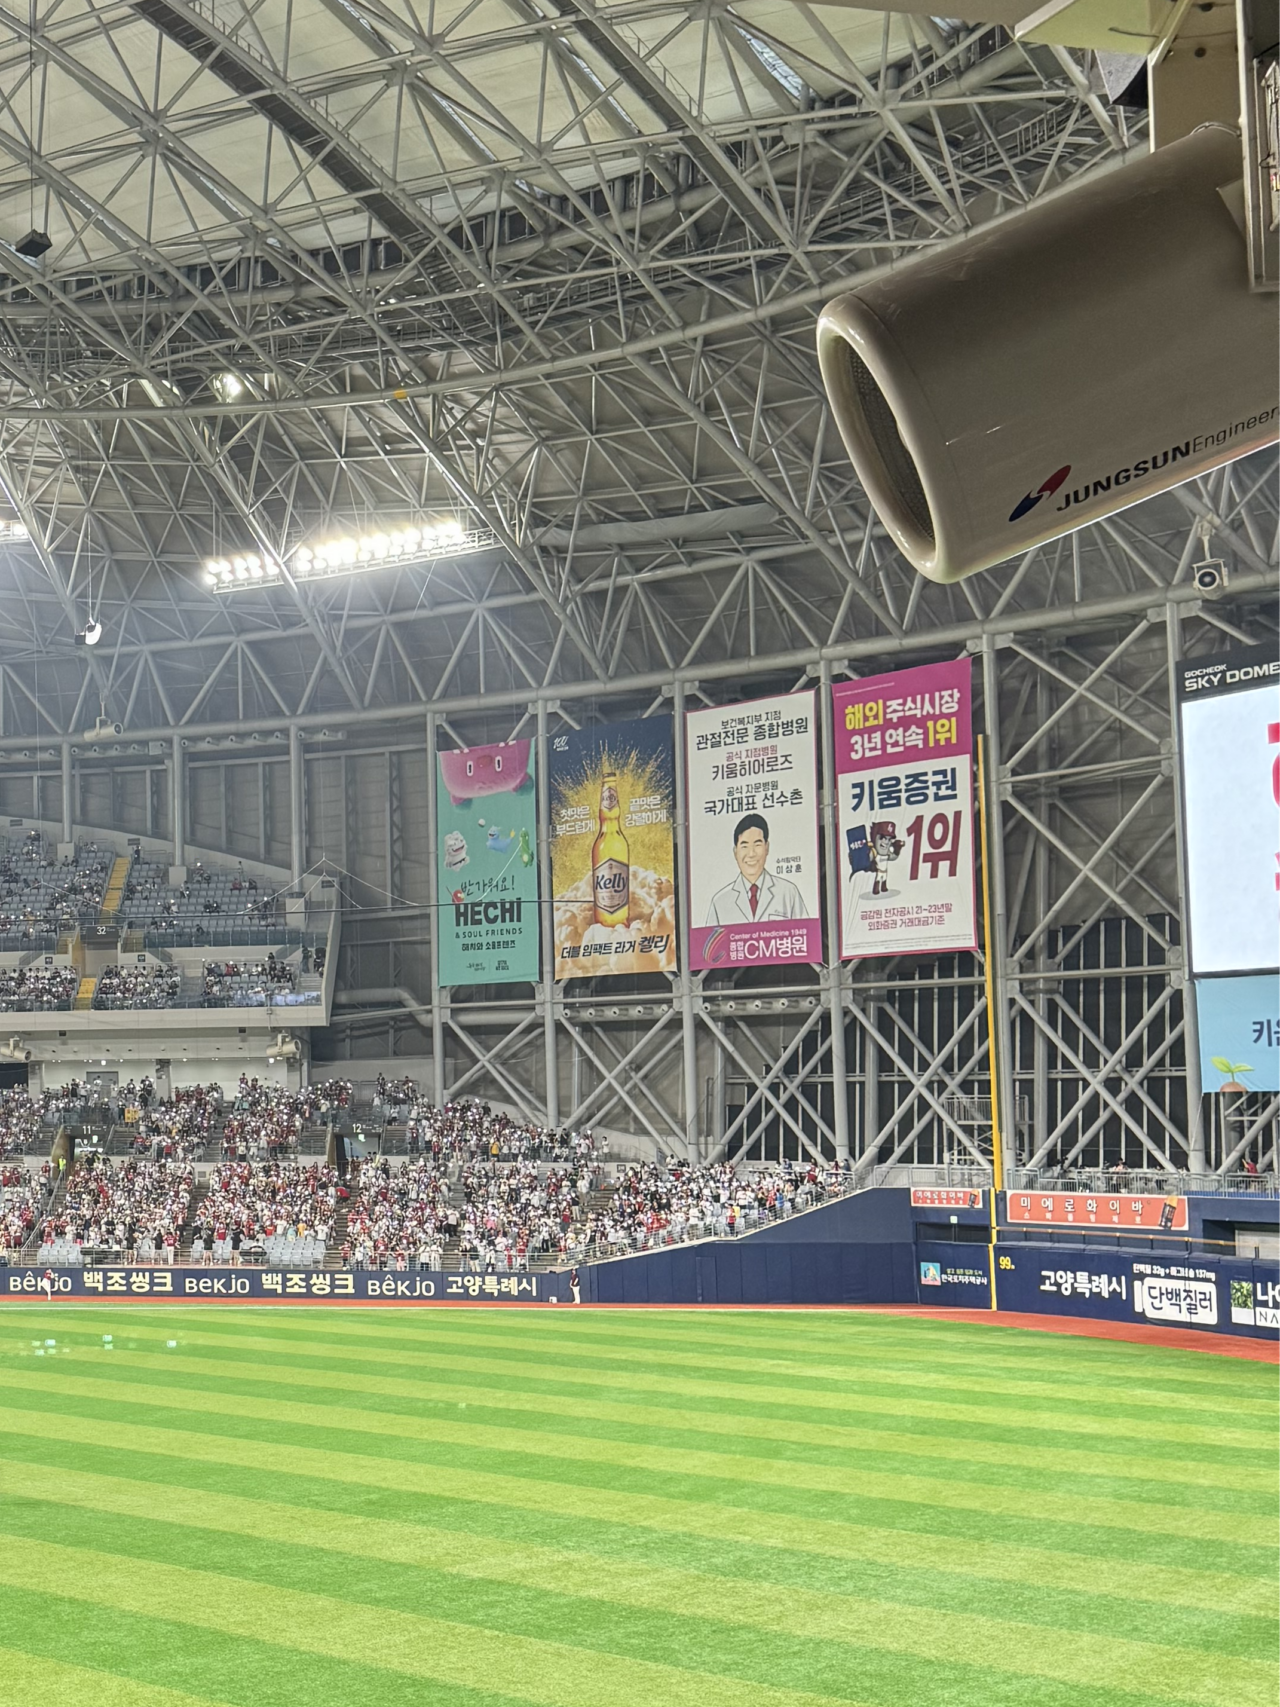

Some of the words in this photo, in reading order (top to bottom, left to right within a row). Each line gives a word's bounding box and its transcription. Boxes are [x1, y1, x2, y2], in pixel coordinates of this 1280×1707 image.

[1056, 441, 1190, 512] JUNGSUN
[1184, 663, 1227, 678] GOCHEOK
[1185, 673, 1222, 691] SKY
[1226, 661, 1280, 683] DOME
[845, 699, 884, 730] 해외
[885, 688, 960, 722] 주식시장
[696, 727, 749, 751] 관절전문
[753, 716, 808, 741] 종합병원
[850, 731, 882, 760] 3년
[885, 725, 924, 754] 연속
[926, 717, 957, 747] 1위
[712, 753, 793, 781] 키움히어로즈
[726, 750, 742, 762] 공식
[726, 785, 743, 797] 공식
[745, 780, 778, 794] 자문병원
[851, 767, 957, 812] 키움증권
[629, 795, 660, 812] 끝맛은
[704, 795, 757, 816] 국가대표
[762, 788, 803, 809] 선수촌
[560, 805, 590, 822] 첫맛은
[625, 809, 667, 828] 강렬하게
[556, 819, 595, 837] 부드럽게
[906, 810, 962, 880] 1위
[460, 875, 515, 897] 반가워요!
[595, 872, 628, 893] Kelly
[455, 897, 522, 927] HECHI
[884, 905, 914, 918] 전자공시
[96, 926, 106, 935] 32
[462, 930, 483, 938] SOUL
[485, 927, 523, 937] FRIENDS
[868, 919, 897, 931] 외화증권
[899, 915, 945, 928] 거래대금기준
[730, 932, 750, 940] Center
[760, 930, 789, 938] Medicine
[462, 942, 483, 951] 해치와
[561, 945, 581, 959] 더블
[582, 942, 613, 957] 임팩트
[614, 940, 637, 953] 라거
[638, 934, 670, 953] 켈리
[744, 935, 807, 959] CM병원
[82, 1125, 91, 1134] 11
[352, 1123, 362, 1133] 12
[83, 1271, 173, 1293] 백조씽크
[261, 1273, 356, 1295] 백조씽크
[446, 1275, 538, 1297] 고양특례시
[1040, 1270, 1127, 1300] 고양특례시
[1148, 1285, 1212, 1315] 단백질러
